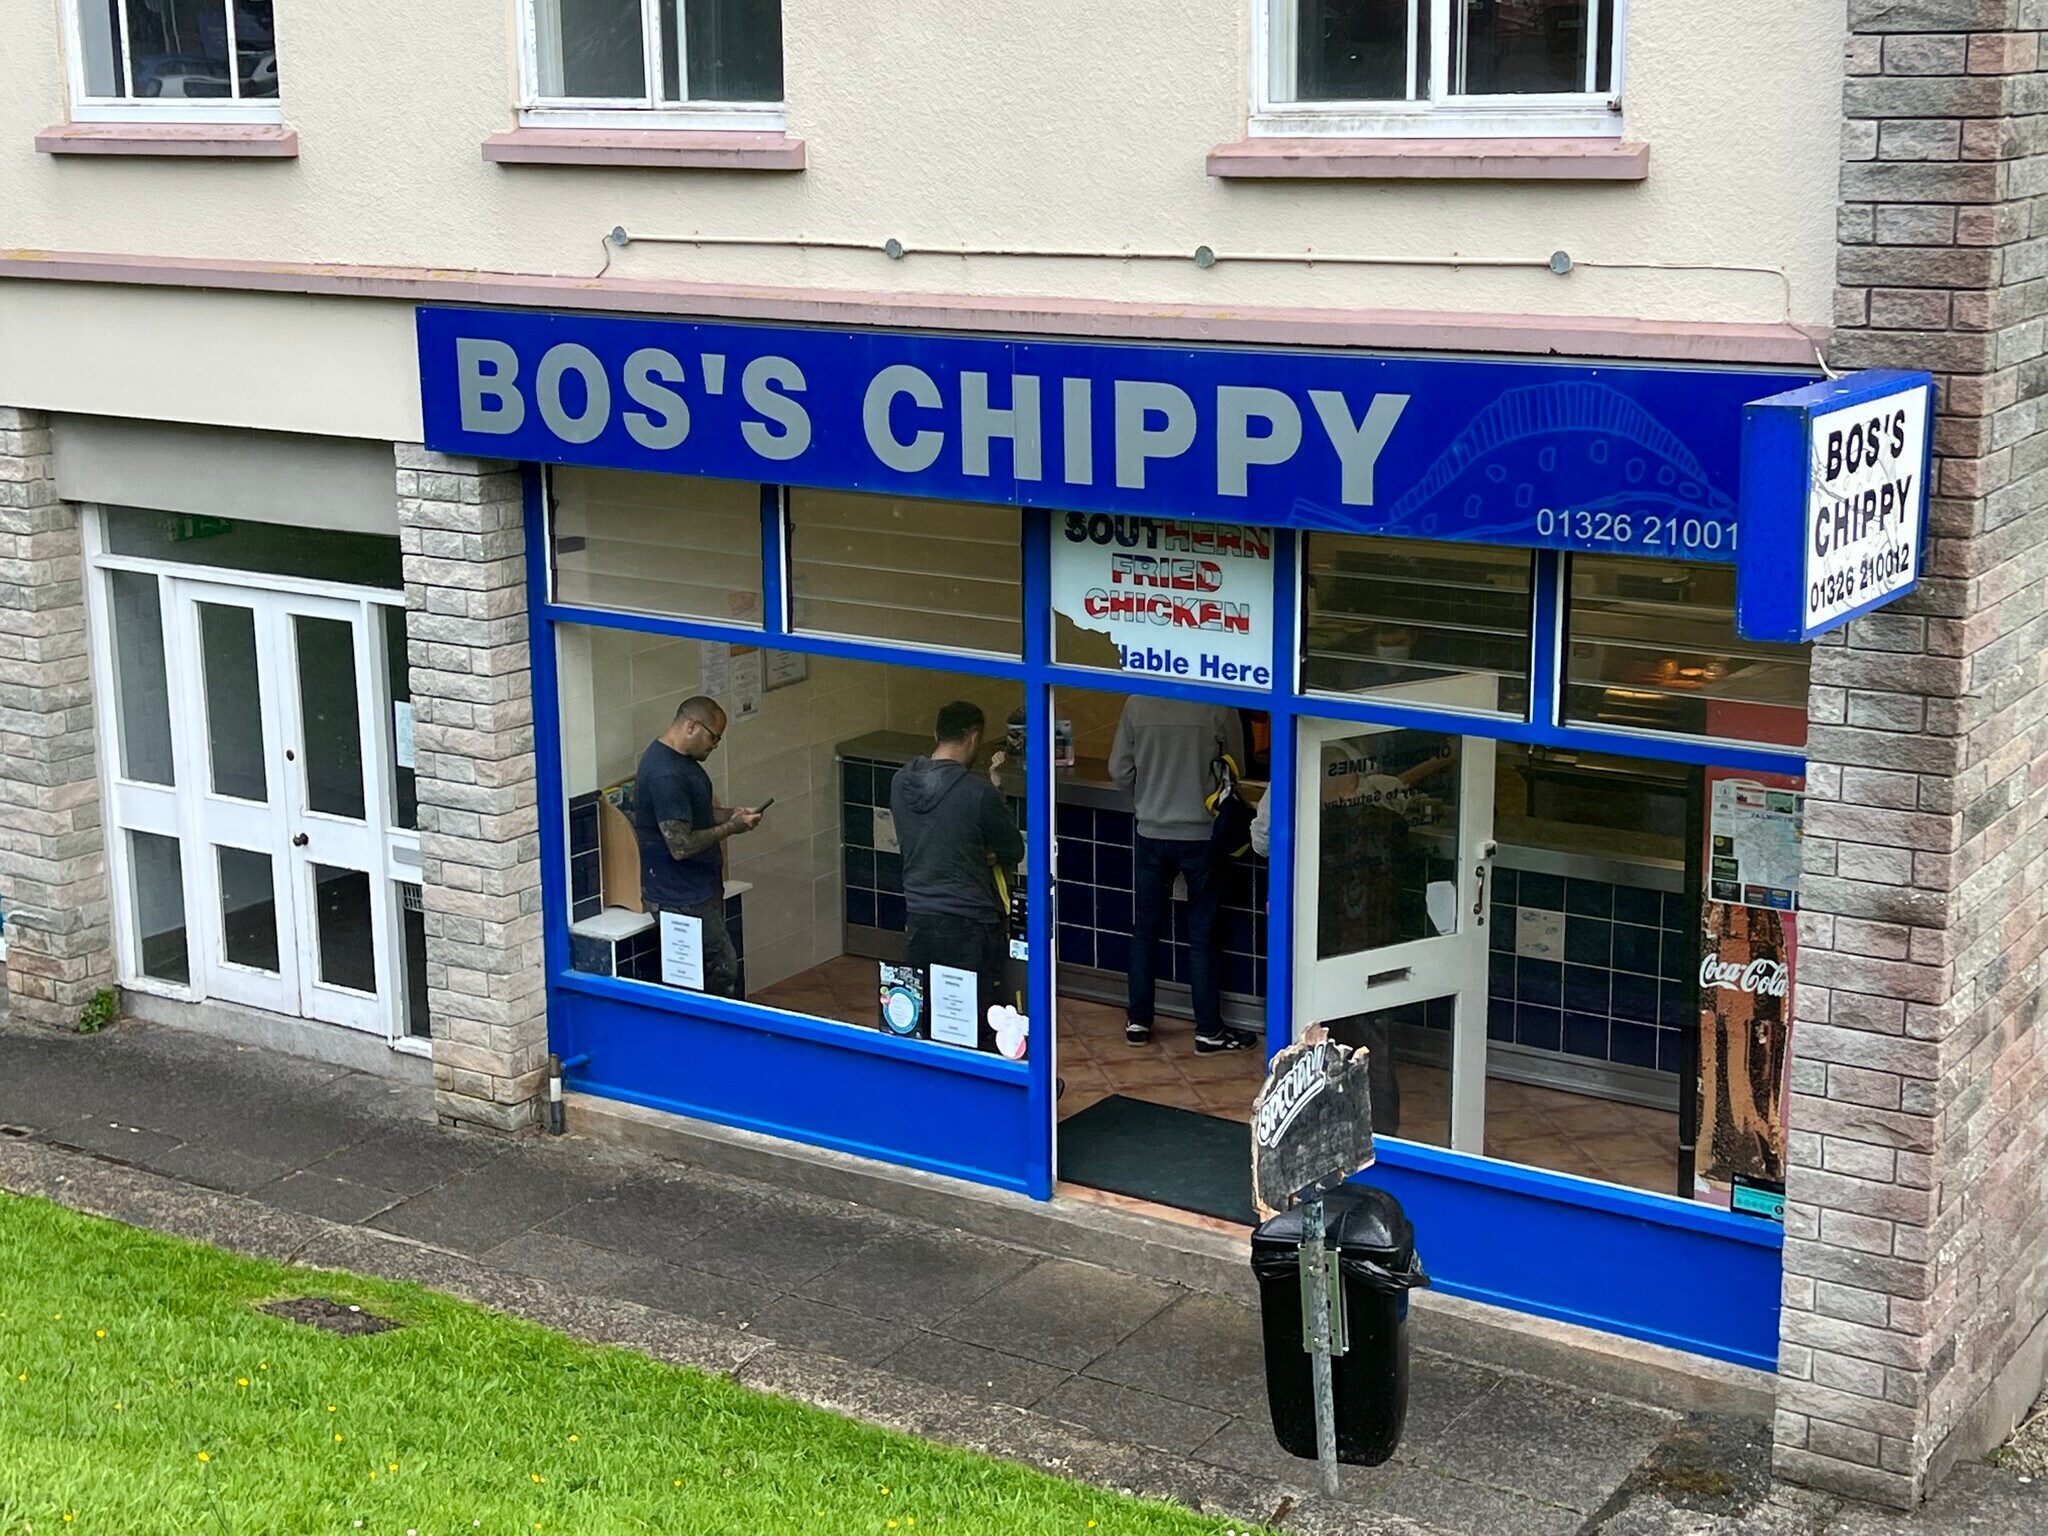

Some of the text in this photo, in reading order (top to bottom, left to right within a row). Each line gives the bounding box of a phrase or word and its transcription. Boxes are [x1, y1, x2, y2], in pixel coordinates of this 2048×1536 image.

[456, 338, 1411, 506] BOS'S CHIPPY
[1826, 409, 1906, 482] BOS'S
[1064, 511, 1270, 560] SOUTHERN
[1537, 508, 1632, 543] 01326
[1815, 475, 1912, 558] CHIPPY
[1112, 553, 1223, 594] FRIED
[1810, 543, 1910, 613] 01326 210012
[1084, 587, 1250, 636] CHICKEN
[1200, 653, 1270, 685] Here
[1699, 952, 1789, 998] Coca-Cola
